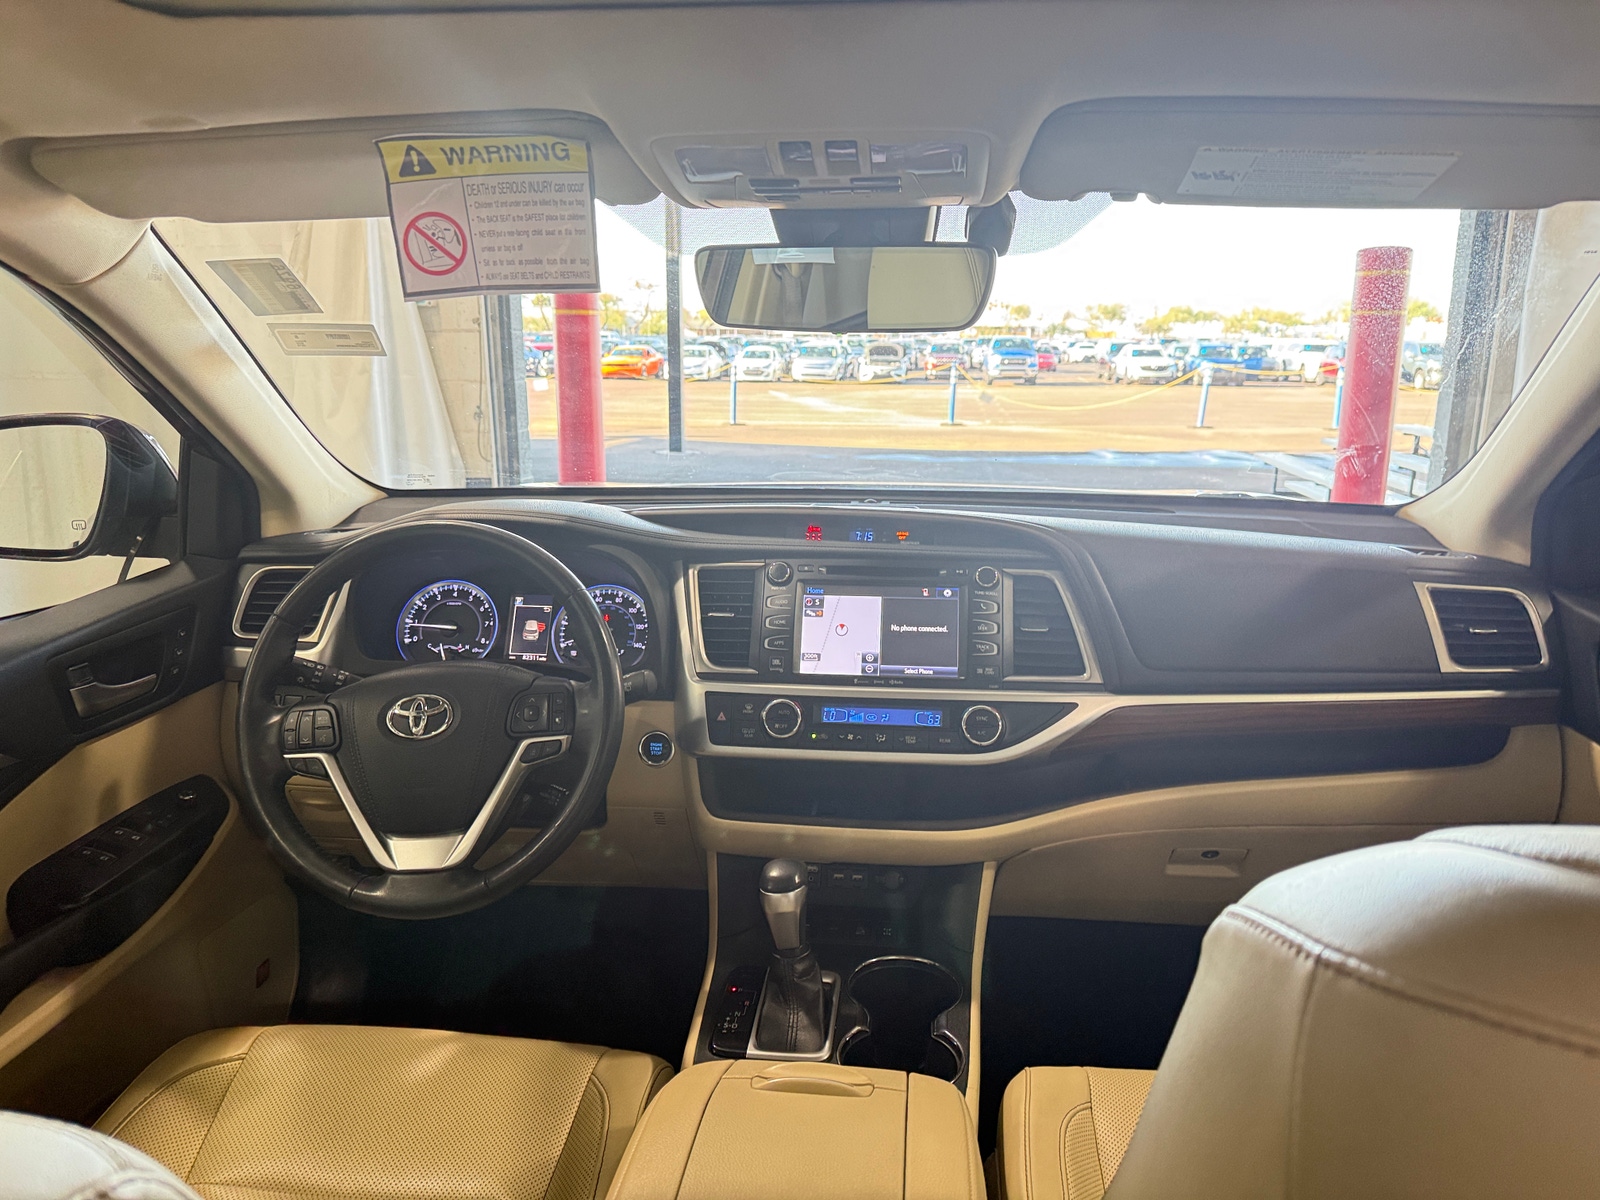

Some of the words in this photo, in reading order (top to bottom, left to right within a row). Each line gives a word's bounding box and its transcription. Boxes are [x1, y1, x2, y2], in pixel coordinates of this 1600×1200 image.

[439, 141, 571, 166] WARNING
[466, 183, 490, 196] DEATH
[490, 185, 497, 195] or
[497, 181, 527, 195] SERIOUS
[528, 180, 553, 193] INJURY
[554, 183, 566, 193] can
[567, 182, 585, 193] occur
[474, 201, 493, 209] Children
[508, 200, 521, 208] under
[552, 199, 559, 208] by
[575, 199, 585, 208] bag
[476, 215, 486, 223] The
[499, 214, 511, 222] SEAT
[524, 213, 544, 222] SAFEST
[545, 213, 558, 222] place
[479, 230, 496, 238] NEVER
[560, 270, 591, 280] RESTRAINTS
[855, 530, 873, 541] 7:15
[890, 624, 900, 632] No
[900, 624, 918, 633] phone
[918, 625, 949, 633] connected.
[927, 714, 940, 725] 63
